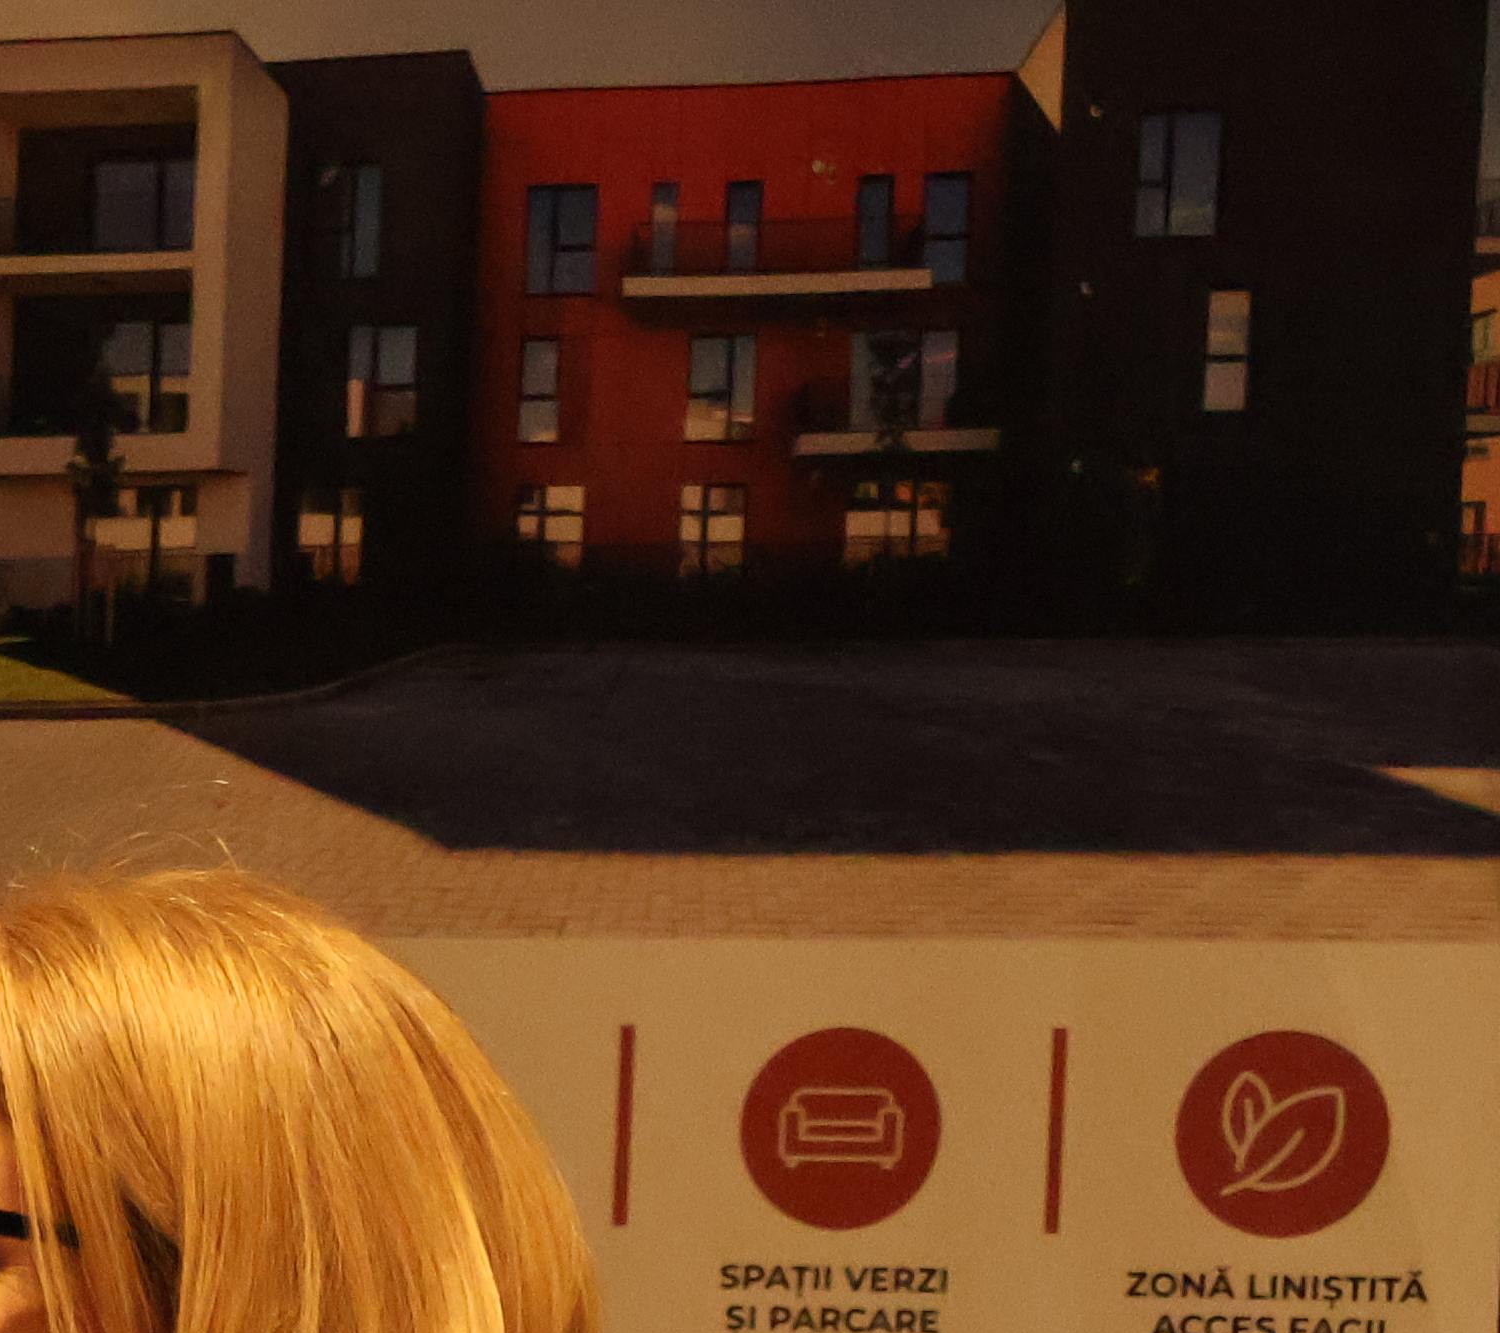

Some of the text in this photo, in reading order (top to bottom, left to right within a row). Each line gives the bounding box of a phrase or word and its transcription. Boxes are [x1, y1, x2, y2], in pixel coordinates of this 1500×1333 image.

[720, 1264, 949, 1298] SPAȚII VERZI
[1125, 1265, 1429, 1311] ZONĂ LINIȘTITĂ
